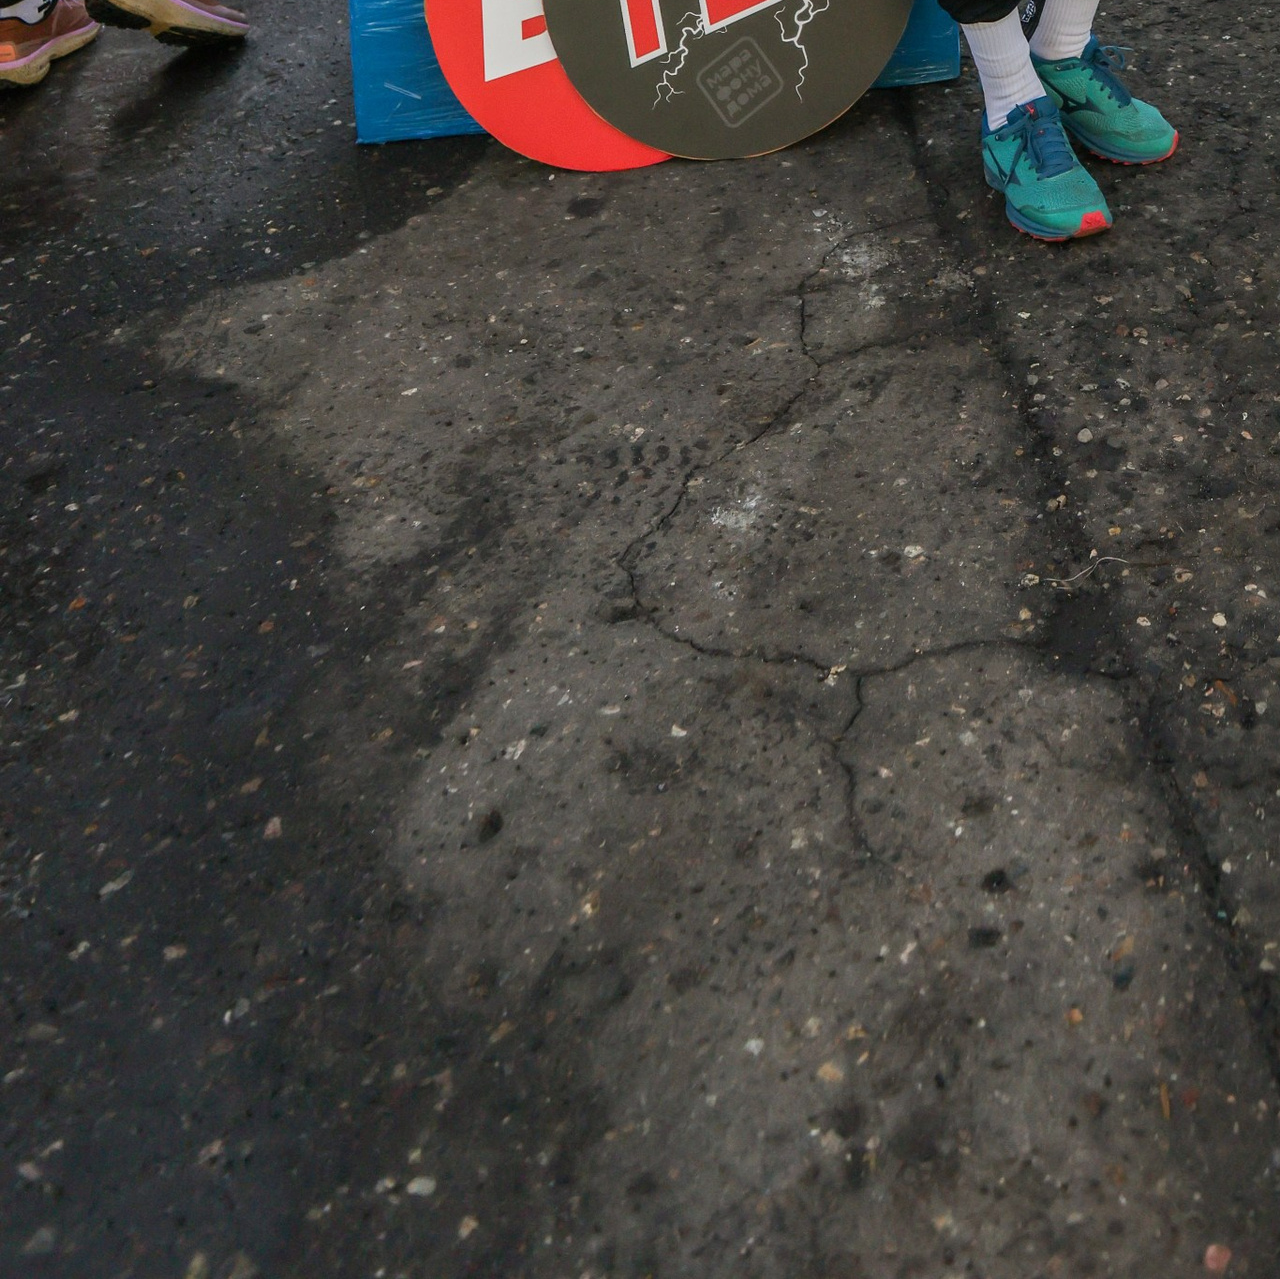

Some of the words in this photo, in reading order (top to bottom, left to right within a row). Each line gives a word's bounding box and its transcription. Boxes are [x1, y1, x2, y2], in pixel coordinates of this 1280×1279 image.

[706, 49, 752, 89] мара
[716, 59, 761, 101] фону
[727, 75, 772, 118] дома
